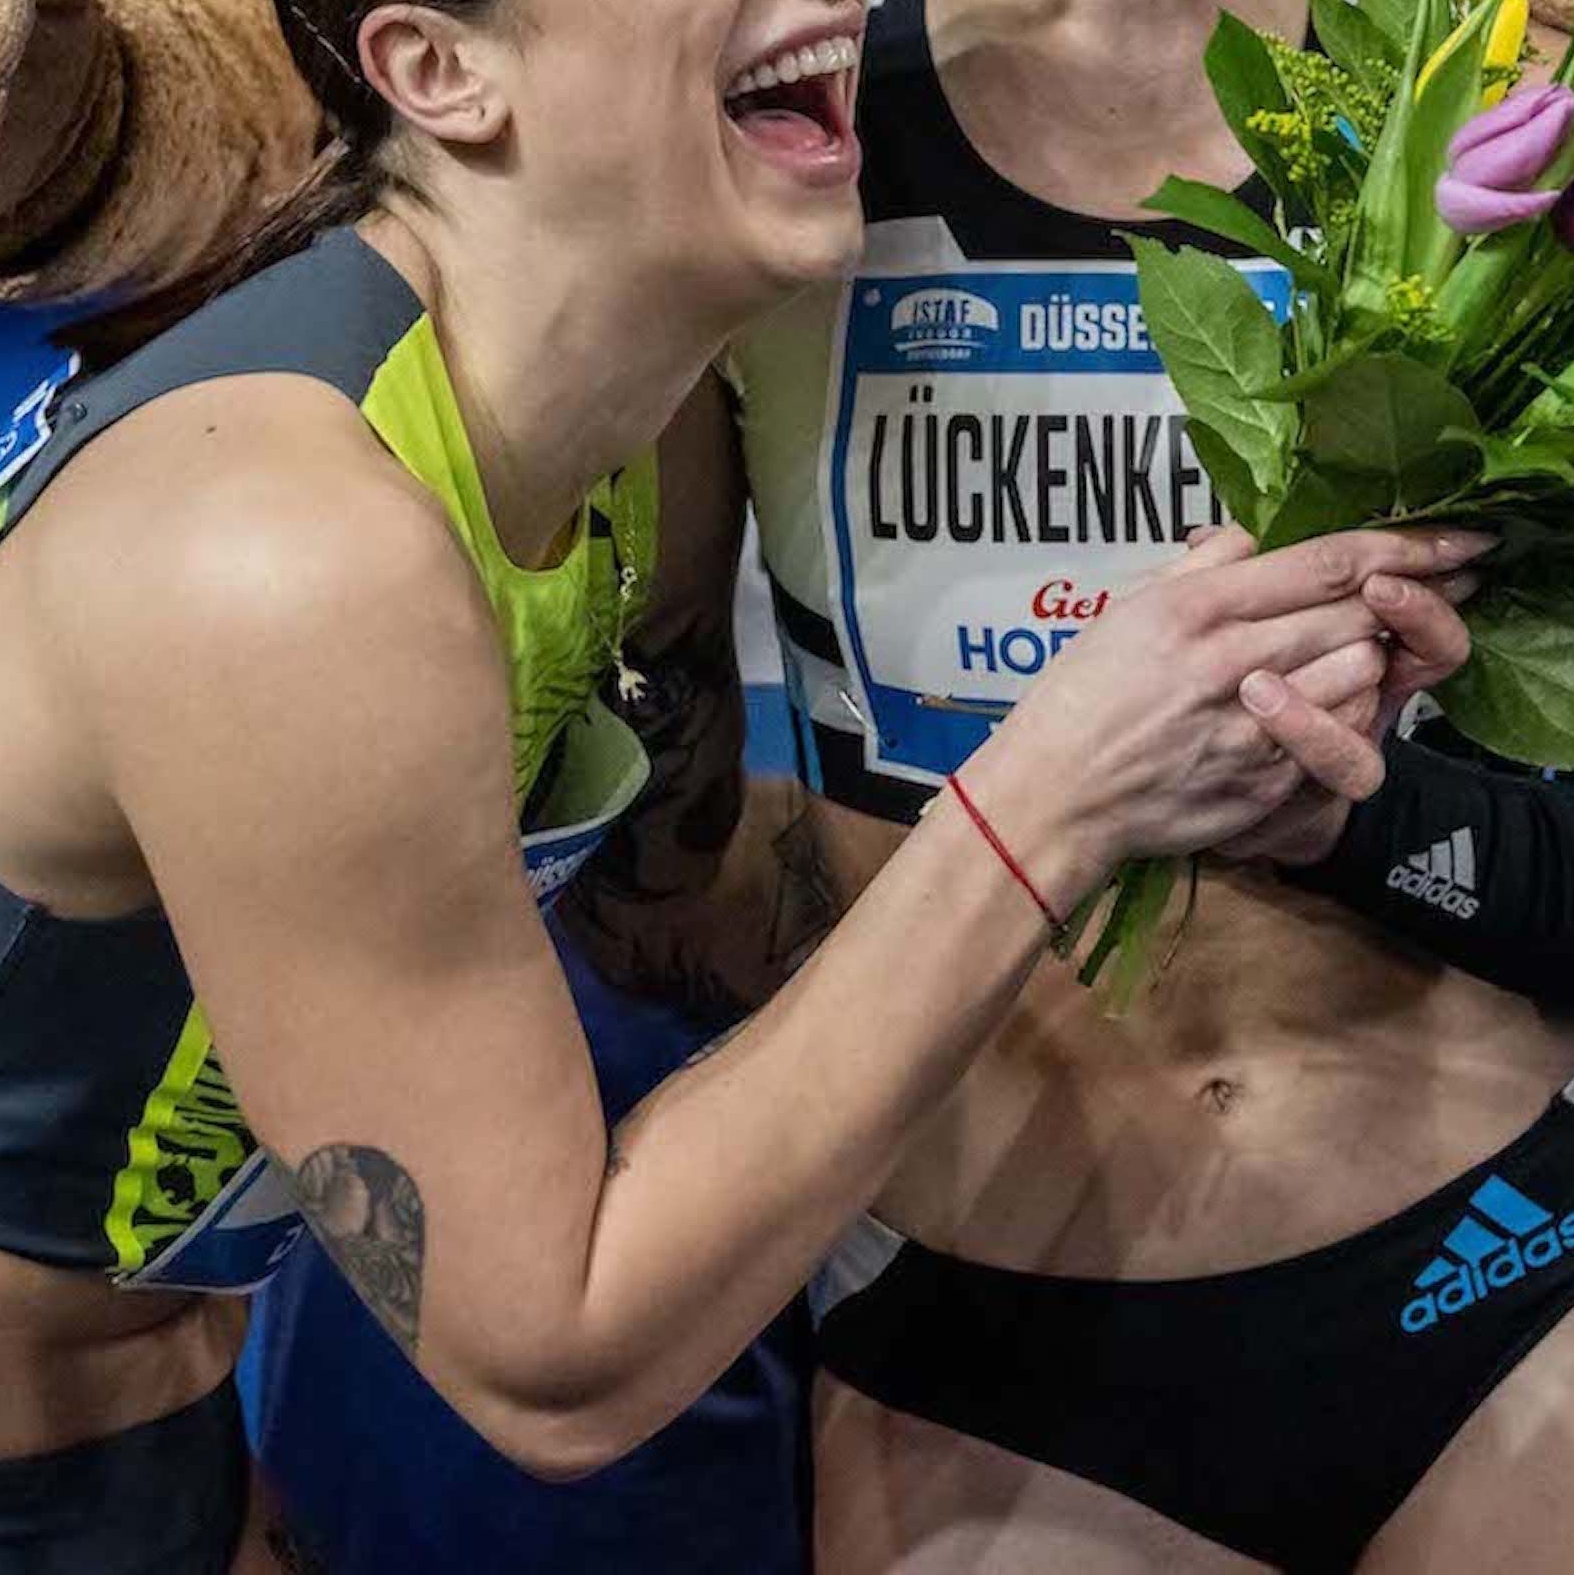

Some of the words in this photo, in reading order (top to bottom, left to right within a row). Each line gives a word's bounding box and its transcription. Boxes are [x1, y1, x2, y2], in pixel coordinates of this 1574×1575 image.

[912, 298, 971, 325] ISTAF
[1019, 293, 1157, 352] DÜSSE
[1031, 578, 1112, 620] Get
[957, 625, 1081, 676] HOF
[1386, 864, 1481, 920] adidas
